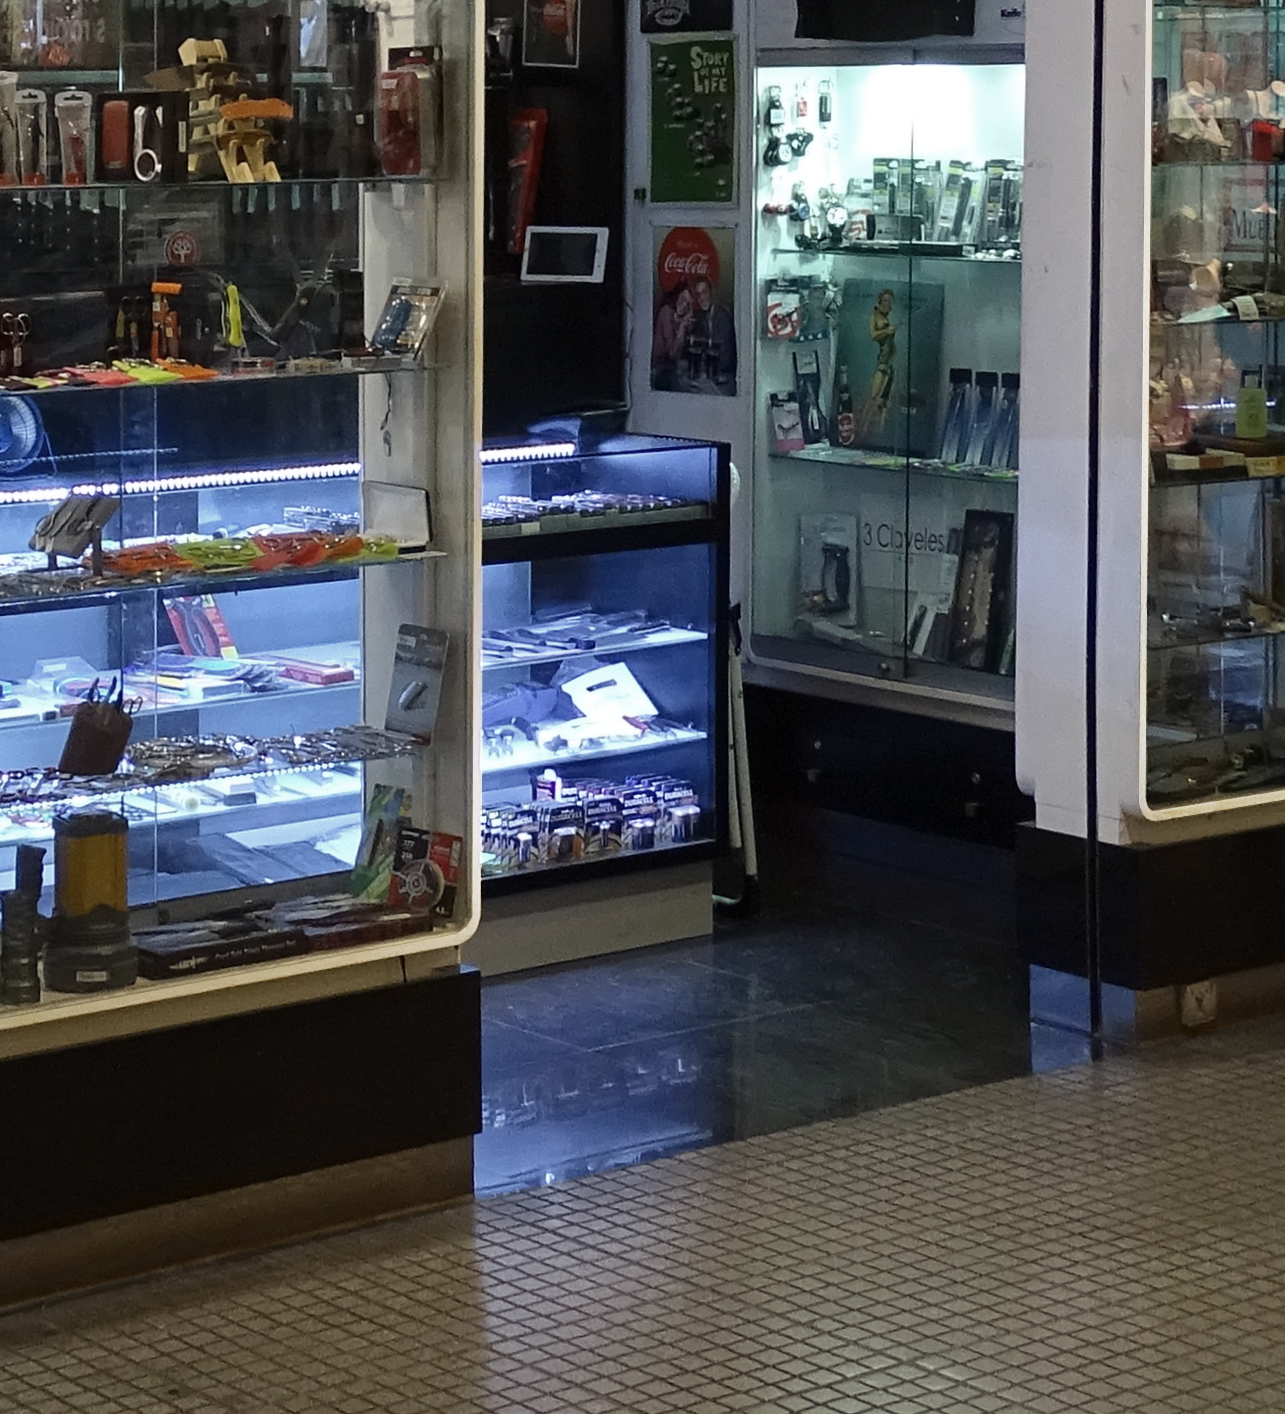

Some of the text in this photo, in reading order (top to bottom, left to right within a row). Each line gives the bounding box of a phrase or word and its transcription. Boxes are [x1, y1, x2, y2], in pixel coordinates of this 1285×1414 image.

[693, 71, 728, 95] LIFE
[664, 251, 710, 274] Coca-Cola
[862, 522, 945, 553] 3 Claveles
